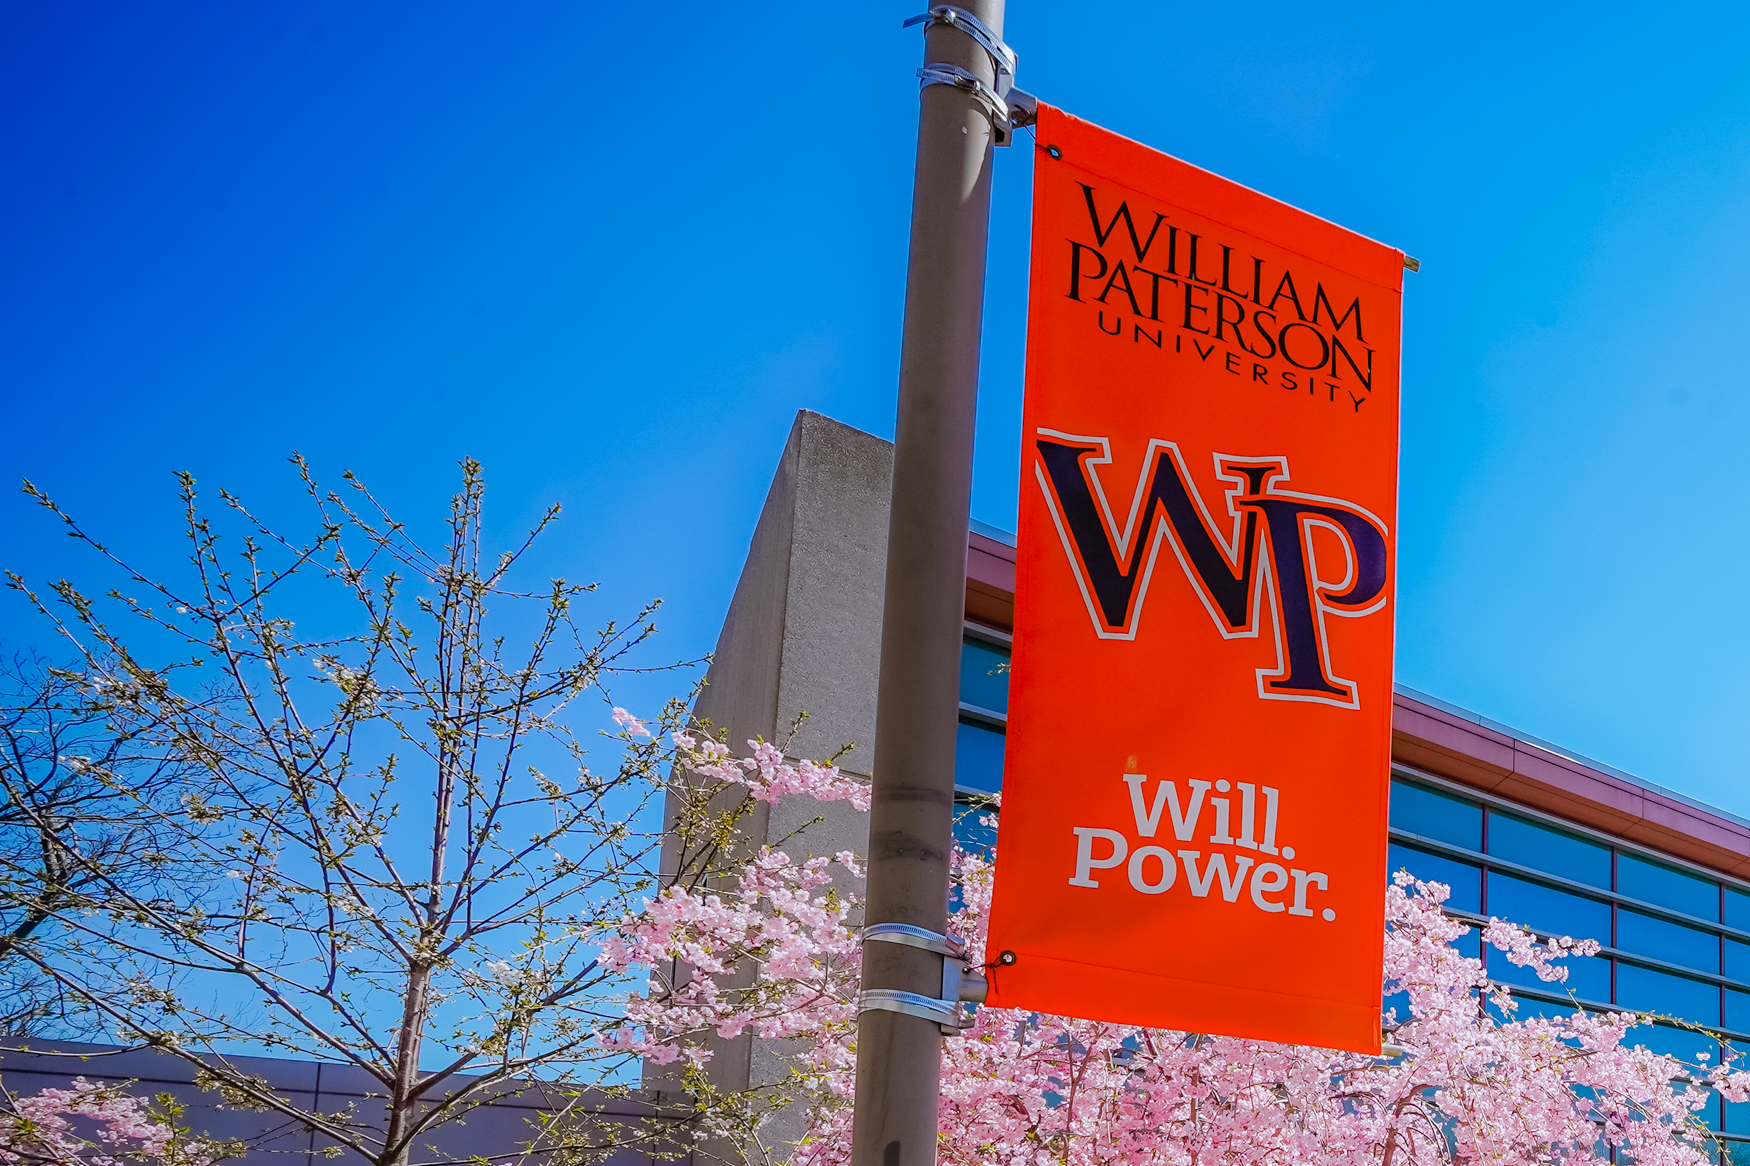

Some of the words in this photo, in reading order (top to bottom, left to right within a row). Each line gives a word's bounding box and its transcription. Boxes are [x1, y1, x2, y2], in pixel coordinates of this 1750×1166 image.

[1064, 238, 1376, 393] PATERSON
[1074, 180, 1370, 344] WILLIAM
[1098, 310, 1366, 413] UNIVERSITY
[1034, 426, 1389, 711] WP
[1068, 826, 1337, 922] Power.
[1122, 773, 1296, 861] Will.
